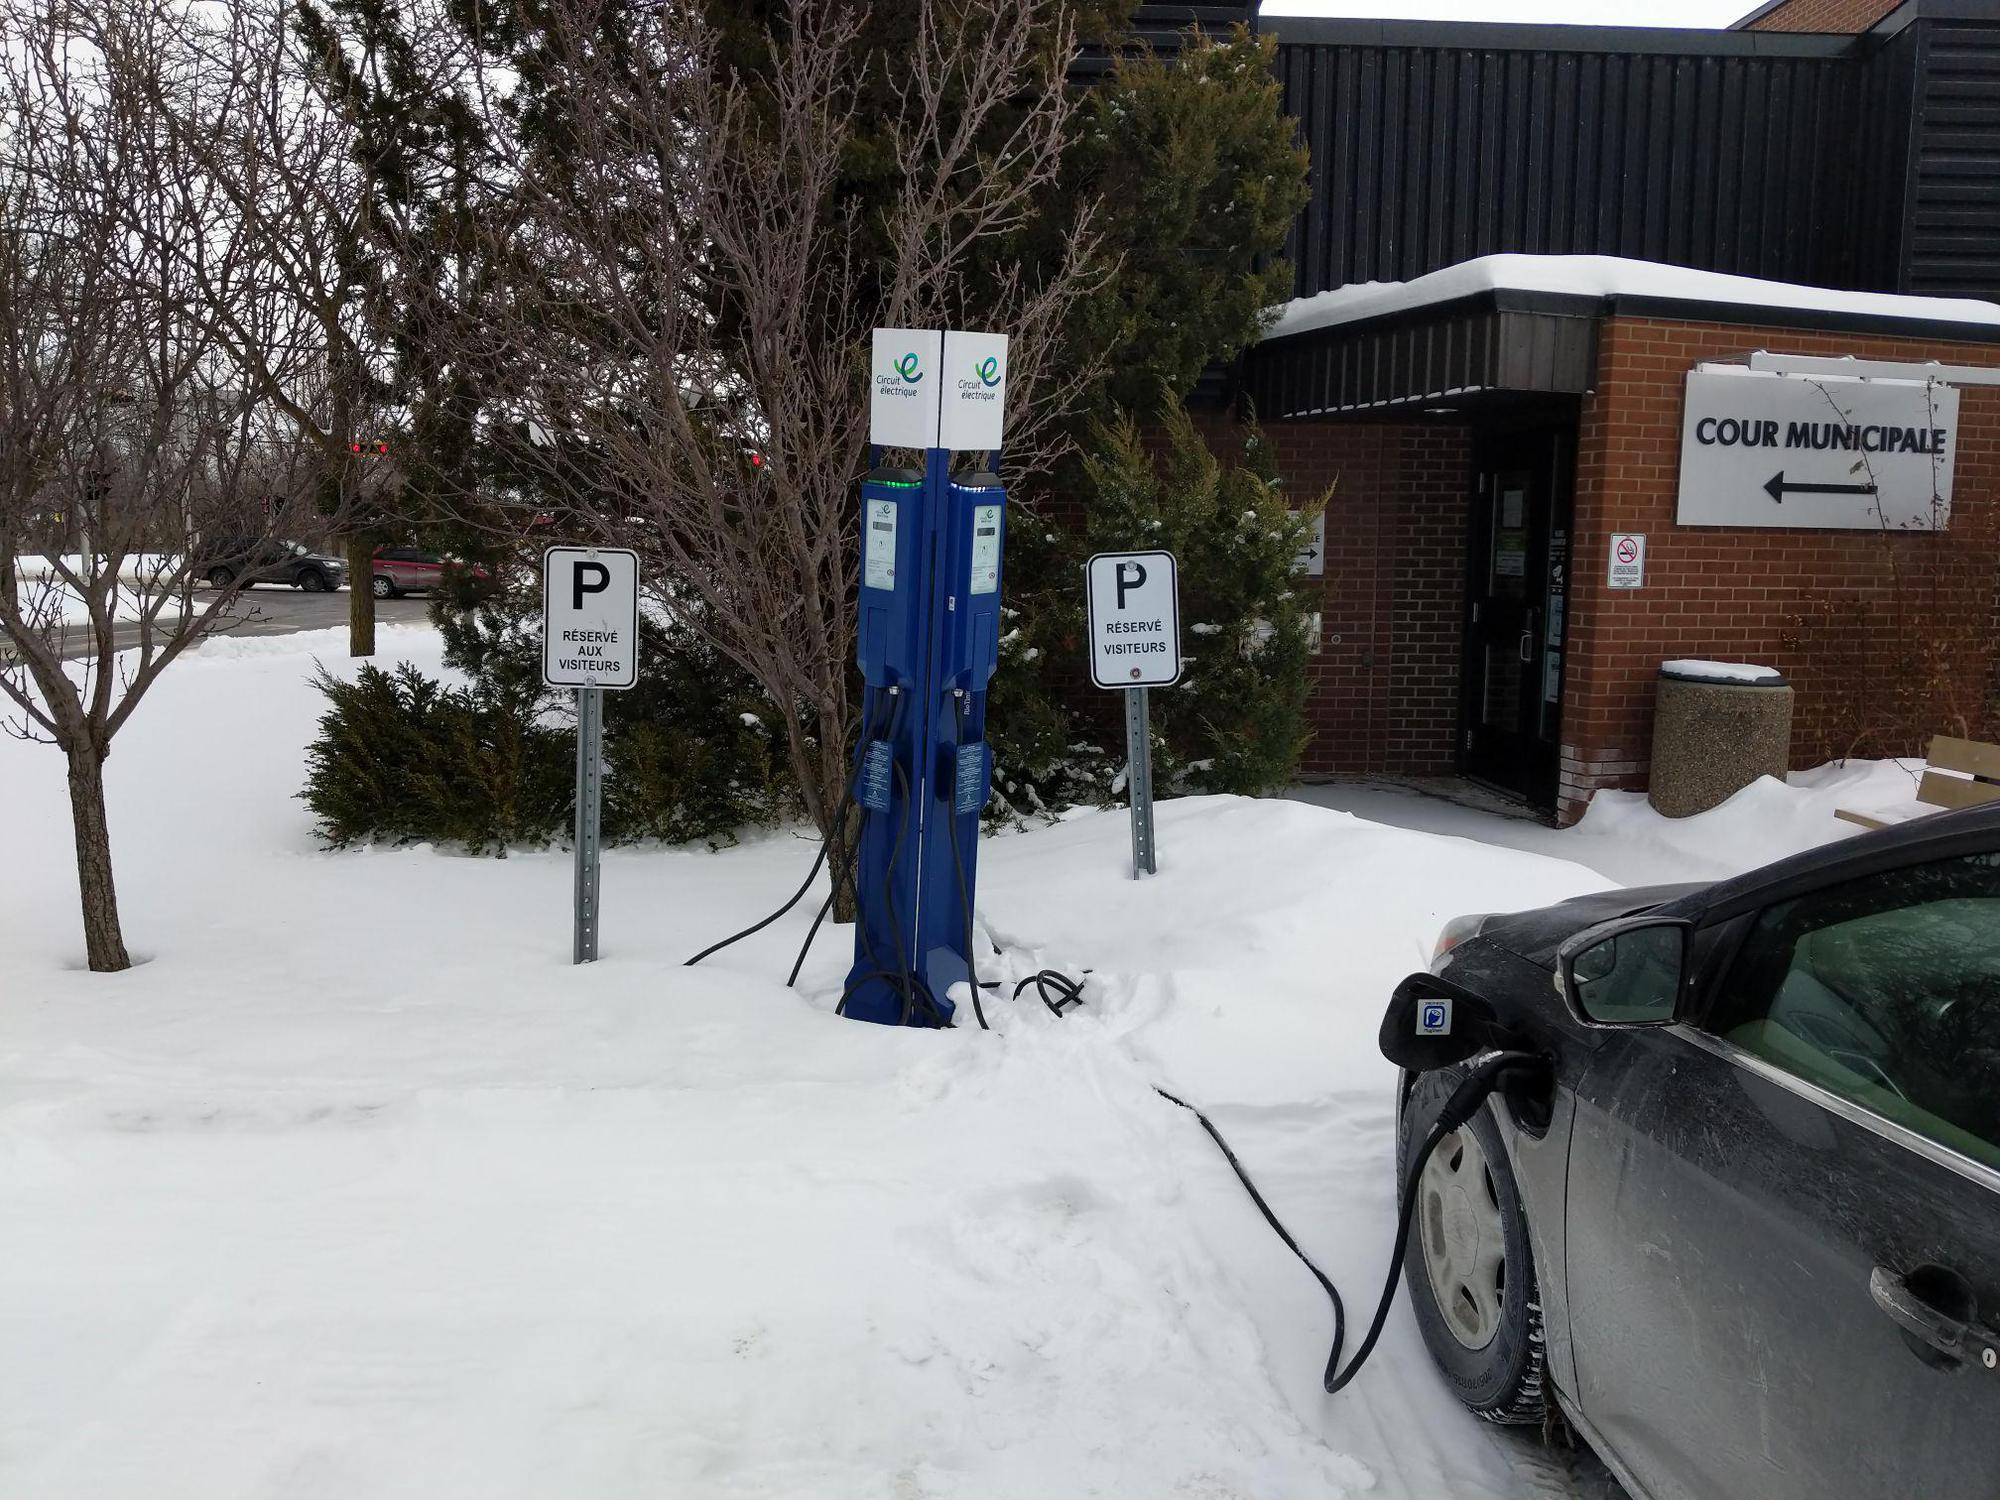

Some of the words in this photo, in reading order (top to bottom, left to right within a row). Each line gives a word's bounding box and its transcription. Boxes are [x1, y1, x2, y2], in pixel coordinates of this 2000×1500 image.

[876, 374, 901, 386] Circuit
[957, 379, 982, 390] Circuit
[880, 385, 918, 400] électrique
[961, 389, 996, 402] électrique
[1696, 417, 1779, 447] COUR
[1785, 421, 1947, 454] MUNICIPALE
[573, 561, 611, 610] P
[1116, 562, 1147, 609] P
[1106, 619, 1162, 634] RÉSERVÉ
[563, 628, 618, 643] RÉSERVÉ
[577, 645, 603, 657] AUX
[1104, 641, 1167, 655] VISITEURS
[559, 659, 621, 672] VISITEURS
